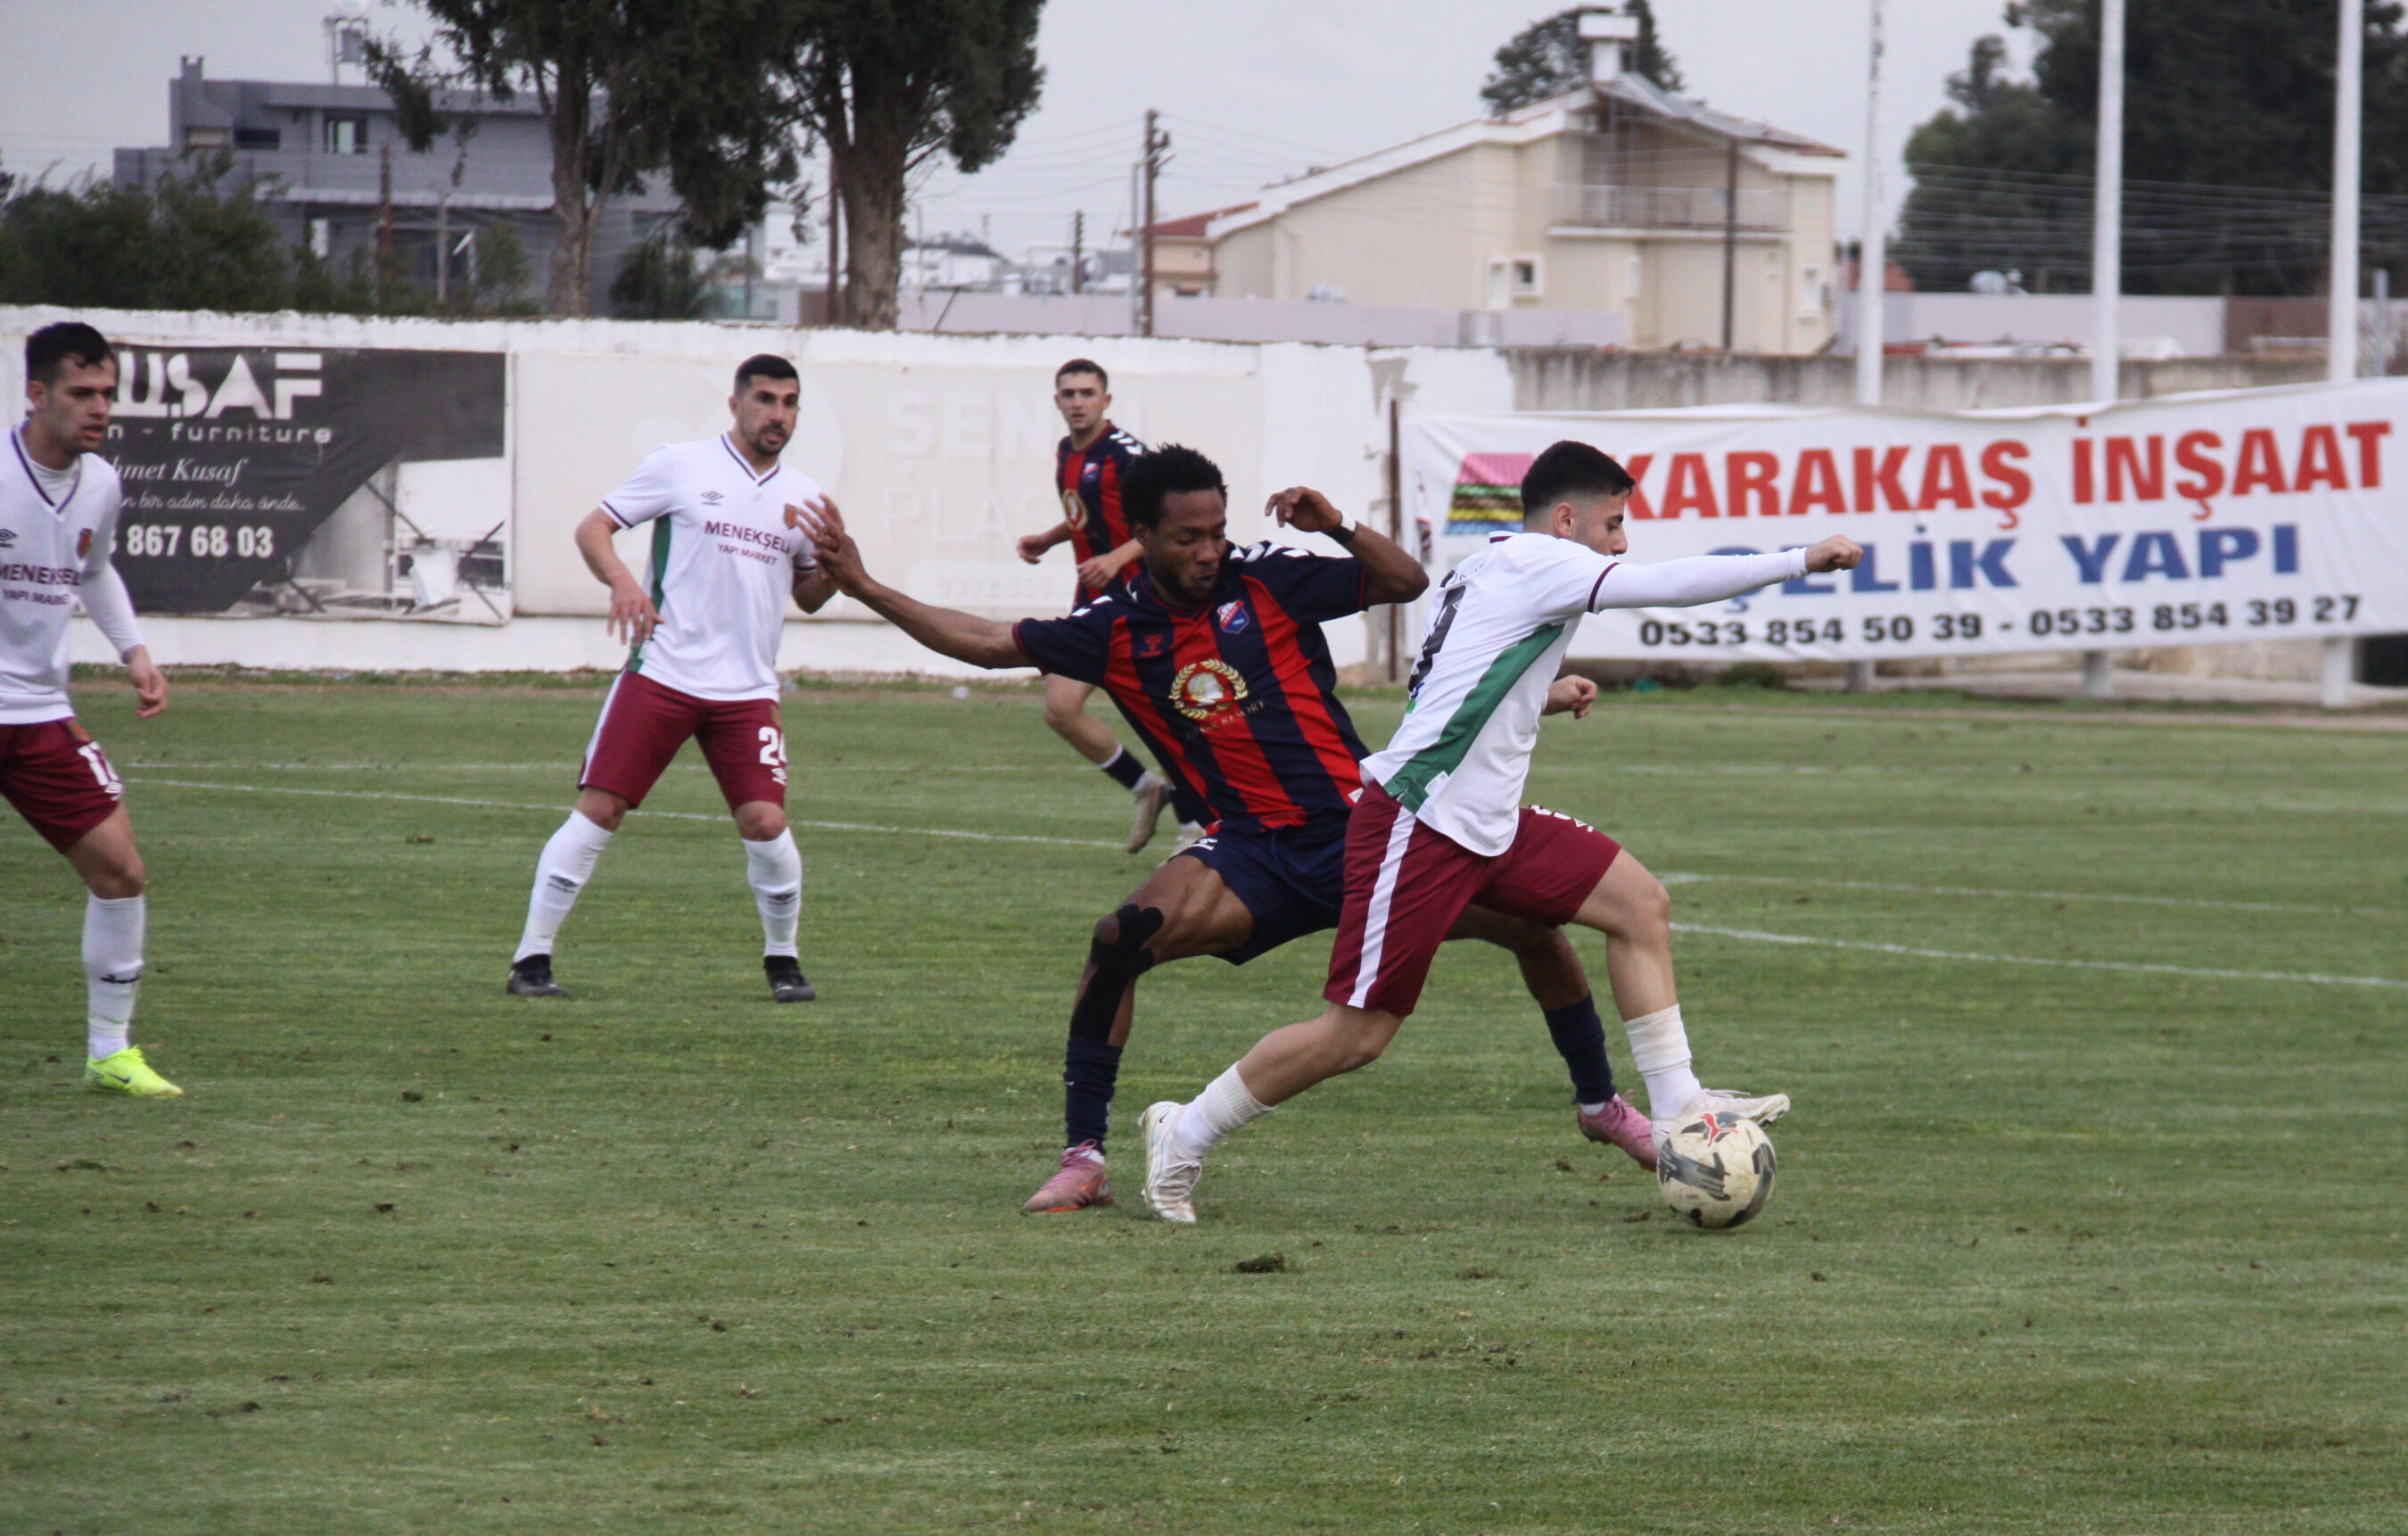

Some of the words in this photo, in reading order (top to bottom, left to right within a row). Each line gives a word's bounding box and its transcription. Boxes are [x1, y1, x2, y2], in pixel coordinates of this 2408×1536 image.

[109, 351, 322, 419] USAF
[171, 422, 333, 444] furniture
[111, 455, 167, 481] hmet
[171, 458, 249, 487] Kusaf
[1611, 439, 2033, 530] KARAKAŞ
[2072, 416, 2392, 521] İNŞAAT
[210, 491, 254, 510] daha
[882, 487, 1065, 543] PLAS
[127, 524, 181, 557] 867
[190, 524, 228, 557] 68
[237, 525, 273, 557] 03
[2058, 523, 2299, 584] YAPI
[1639, 620, 1747, 647] 0533
[1766, 618, 1843, 644] 854
[1863, 615, 1914, 641] 50
[1932, 613, 1983, 640] 39
[2029, 607, 2134, 637] 0533
[2153, 602, 2229, 632] 854
[2247, 599, 2297, 626] 39
[2313, 594, 2361, 623] 27
